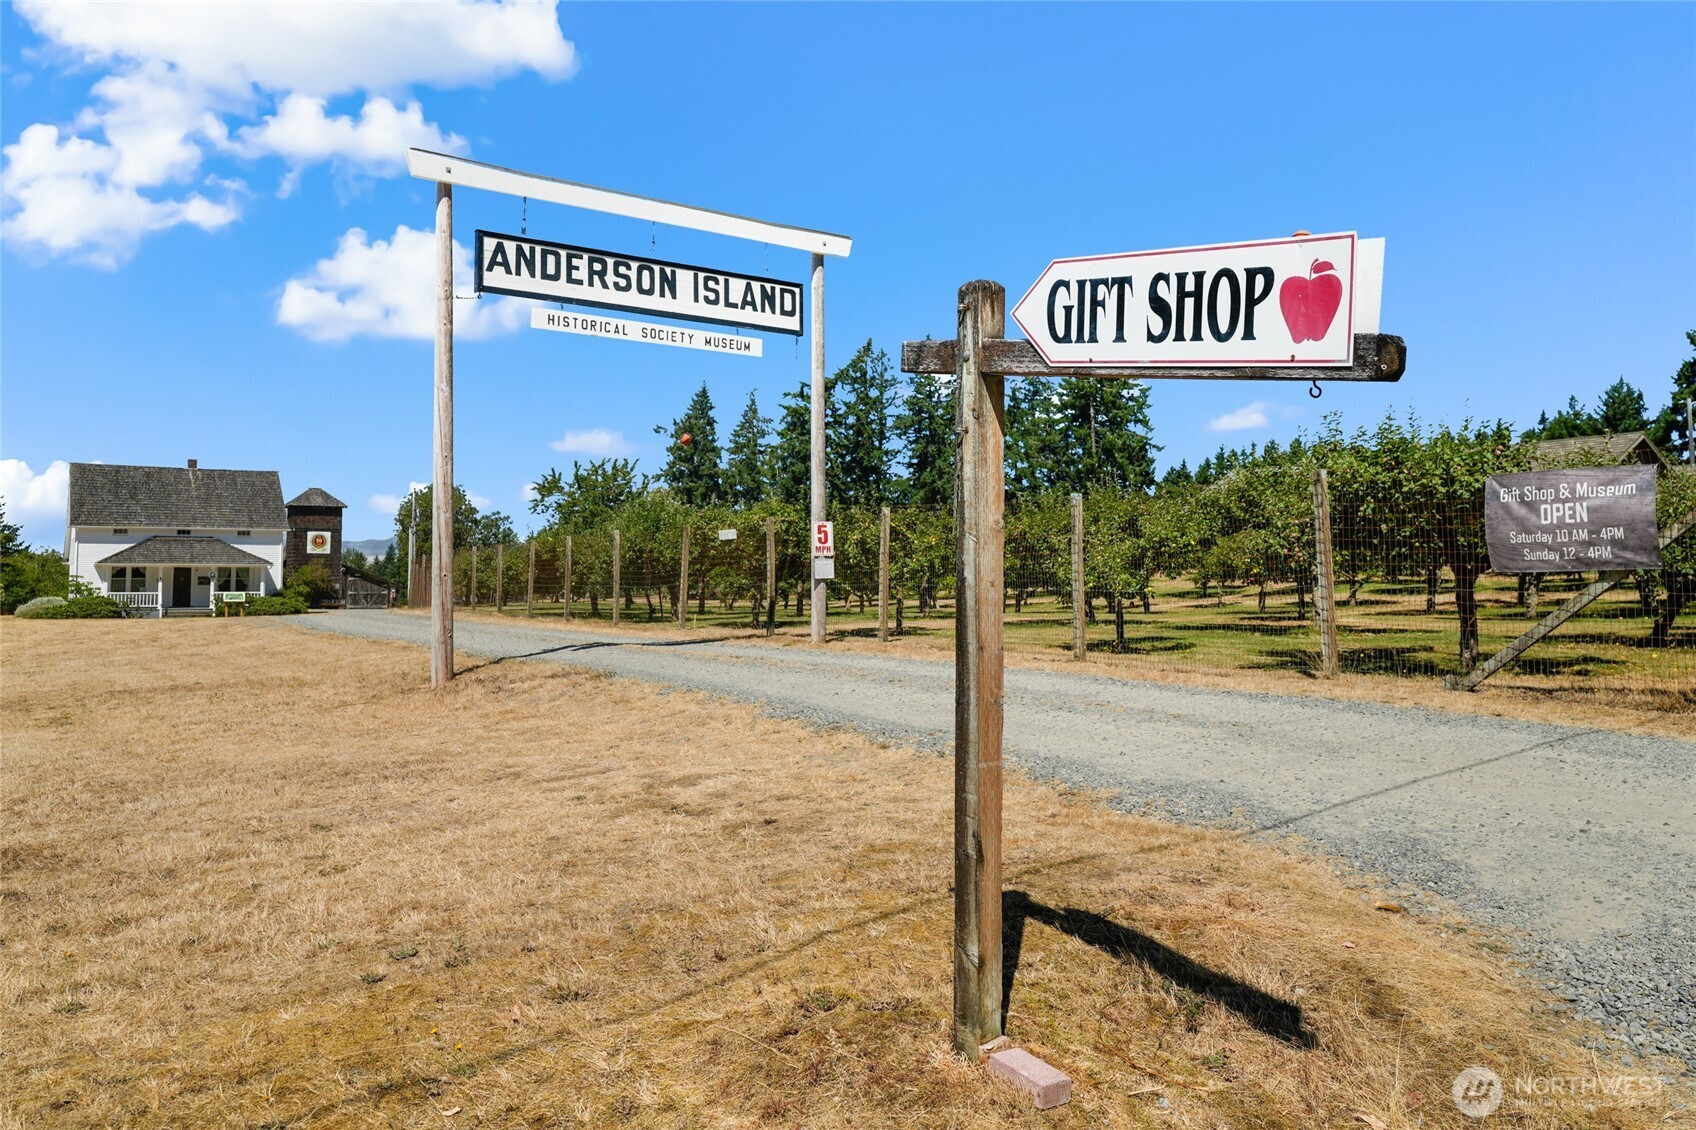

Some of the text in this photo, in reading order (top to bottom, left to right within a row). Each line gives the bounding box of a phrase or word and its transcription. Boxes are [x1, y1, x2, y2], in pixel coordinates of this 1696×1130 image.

[486, 240, 797, 317] ANDERSON ISLAND
[1046, 266, 1275, 344] GIFT SHOP
[546, 313, 751, 353] HISTORICAL SOCIETY MUSEUM
[1500, 482, 1636, 503] Gift Shop & Museum
[1540, 502, 1588, 524] OPEN
[817, 524, 829, 545] 5
[1510, 530, 1553, 544] Saturday
[1556, 529, 1569, 542] 10
[1572, 529, 1588, 542] AM
[1600, 527, 1625, 540] 4PM
[815, 545, 832, 554] MPH
[1524, 548, 1560, 562] Sunday
[1563, 547, 1576, 560] 12
[1587, 546, 1612, 559] 4PM
